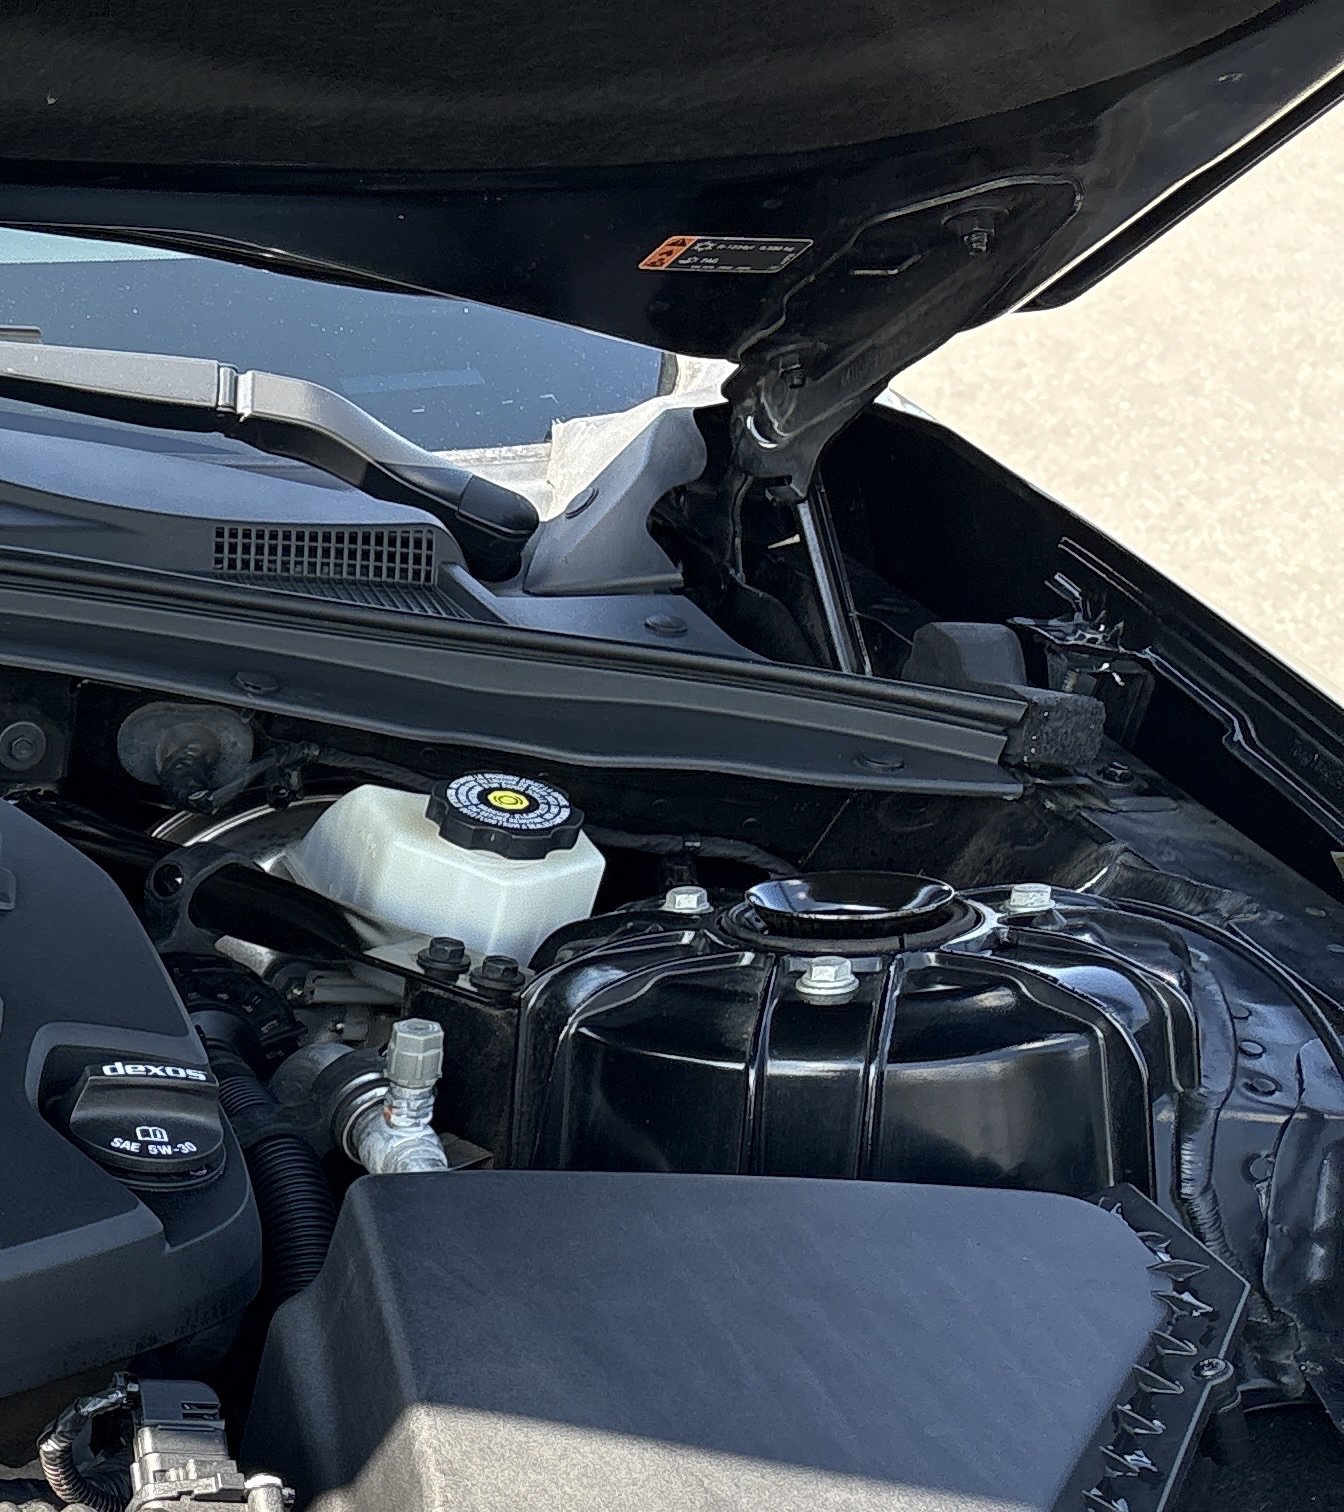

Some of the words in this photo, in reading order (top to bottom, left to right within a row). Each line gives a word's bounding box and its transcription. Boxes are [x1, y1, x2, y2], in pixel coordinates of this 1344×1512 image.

[102, 1061, 208, 1081] dexos
[110, 1137, 141, 1153] SAE
[147, 1141, 198, 1155] 5W-30
